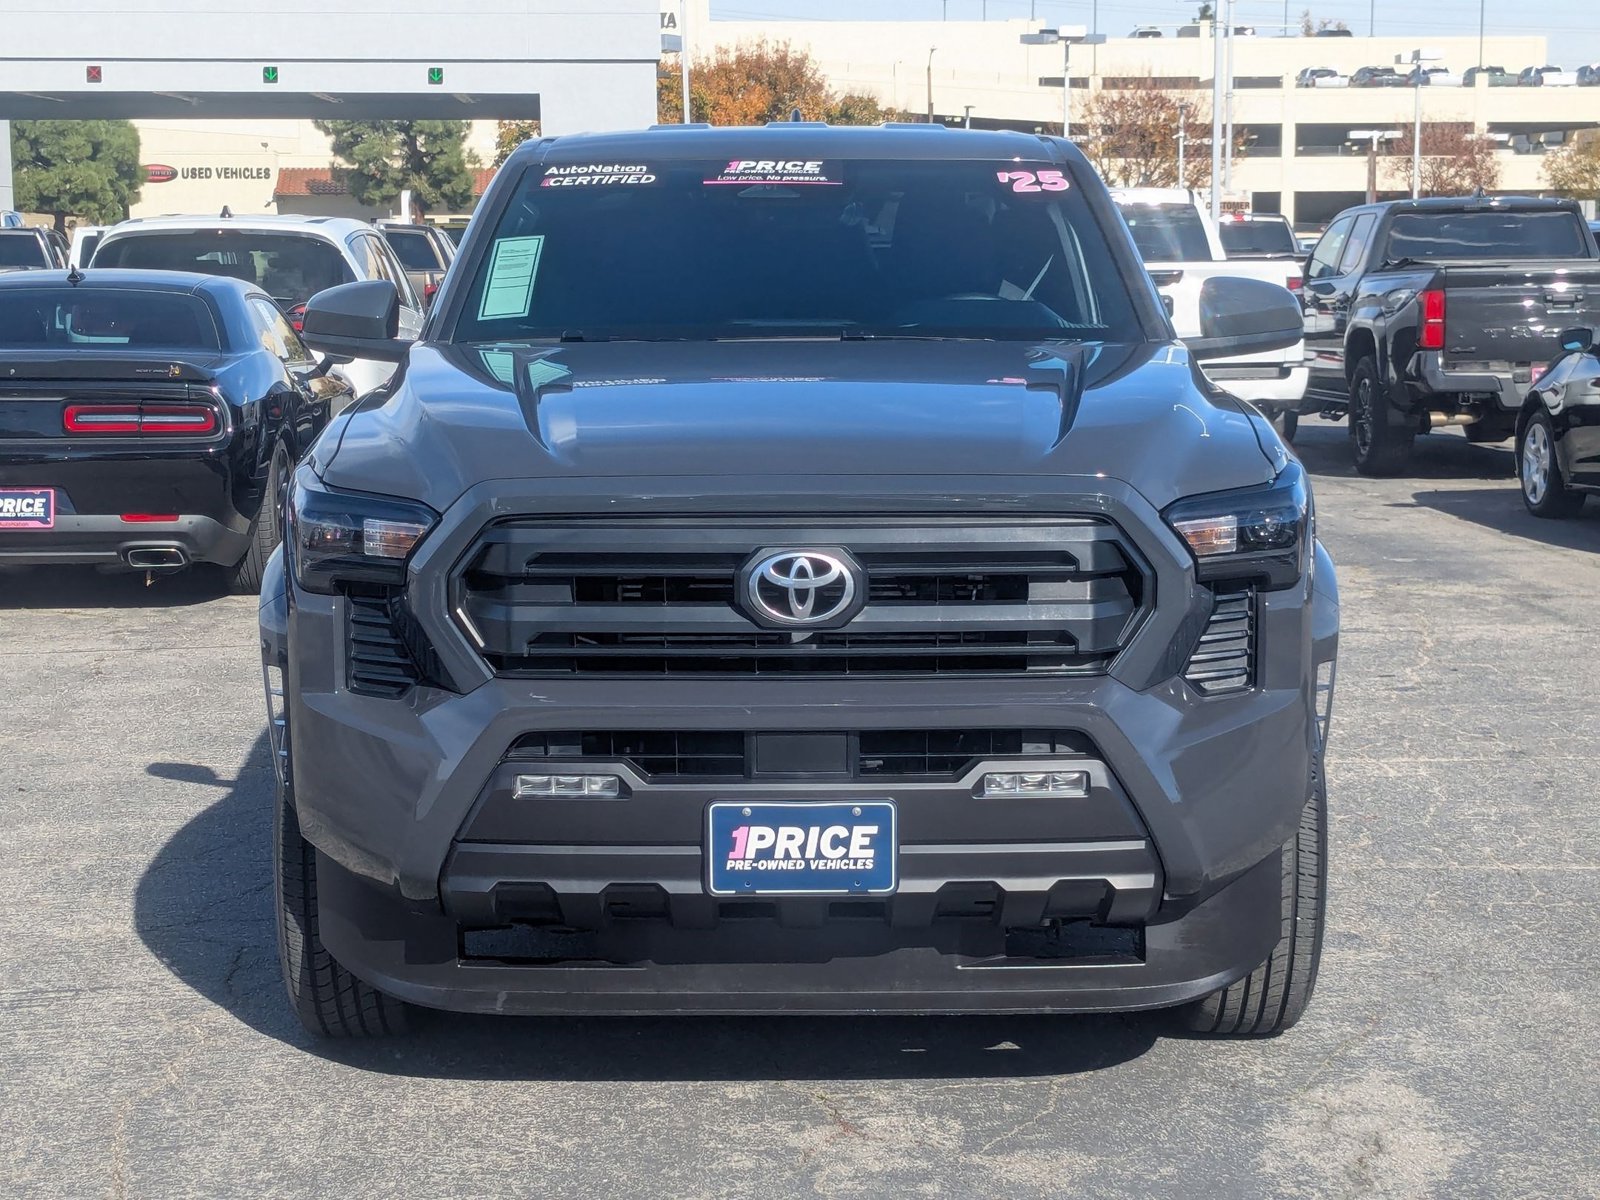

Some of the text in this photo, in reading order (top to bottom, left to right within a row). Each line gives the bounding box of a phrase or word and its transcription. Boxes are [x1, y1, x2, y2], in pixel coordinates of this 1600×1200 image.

[544, 164, 647, 175] AutoNation
[726, 160, 824, 170] 1PRICE
[181, 167, 212, 179] USED
[215, 167, 271, 179] VEHICLES
[549, 174, 656, 186] CERTIFIED
[996, 170, 1070, 192] '25
[1205, 201, 1250, 210] CTOMER
[0, 498, 47, 513] RICE
[728, 825, 879, 859] 1PRICE
[726, 858, 874, 871] PRE-OWNED VEHICLES
